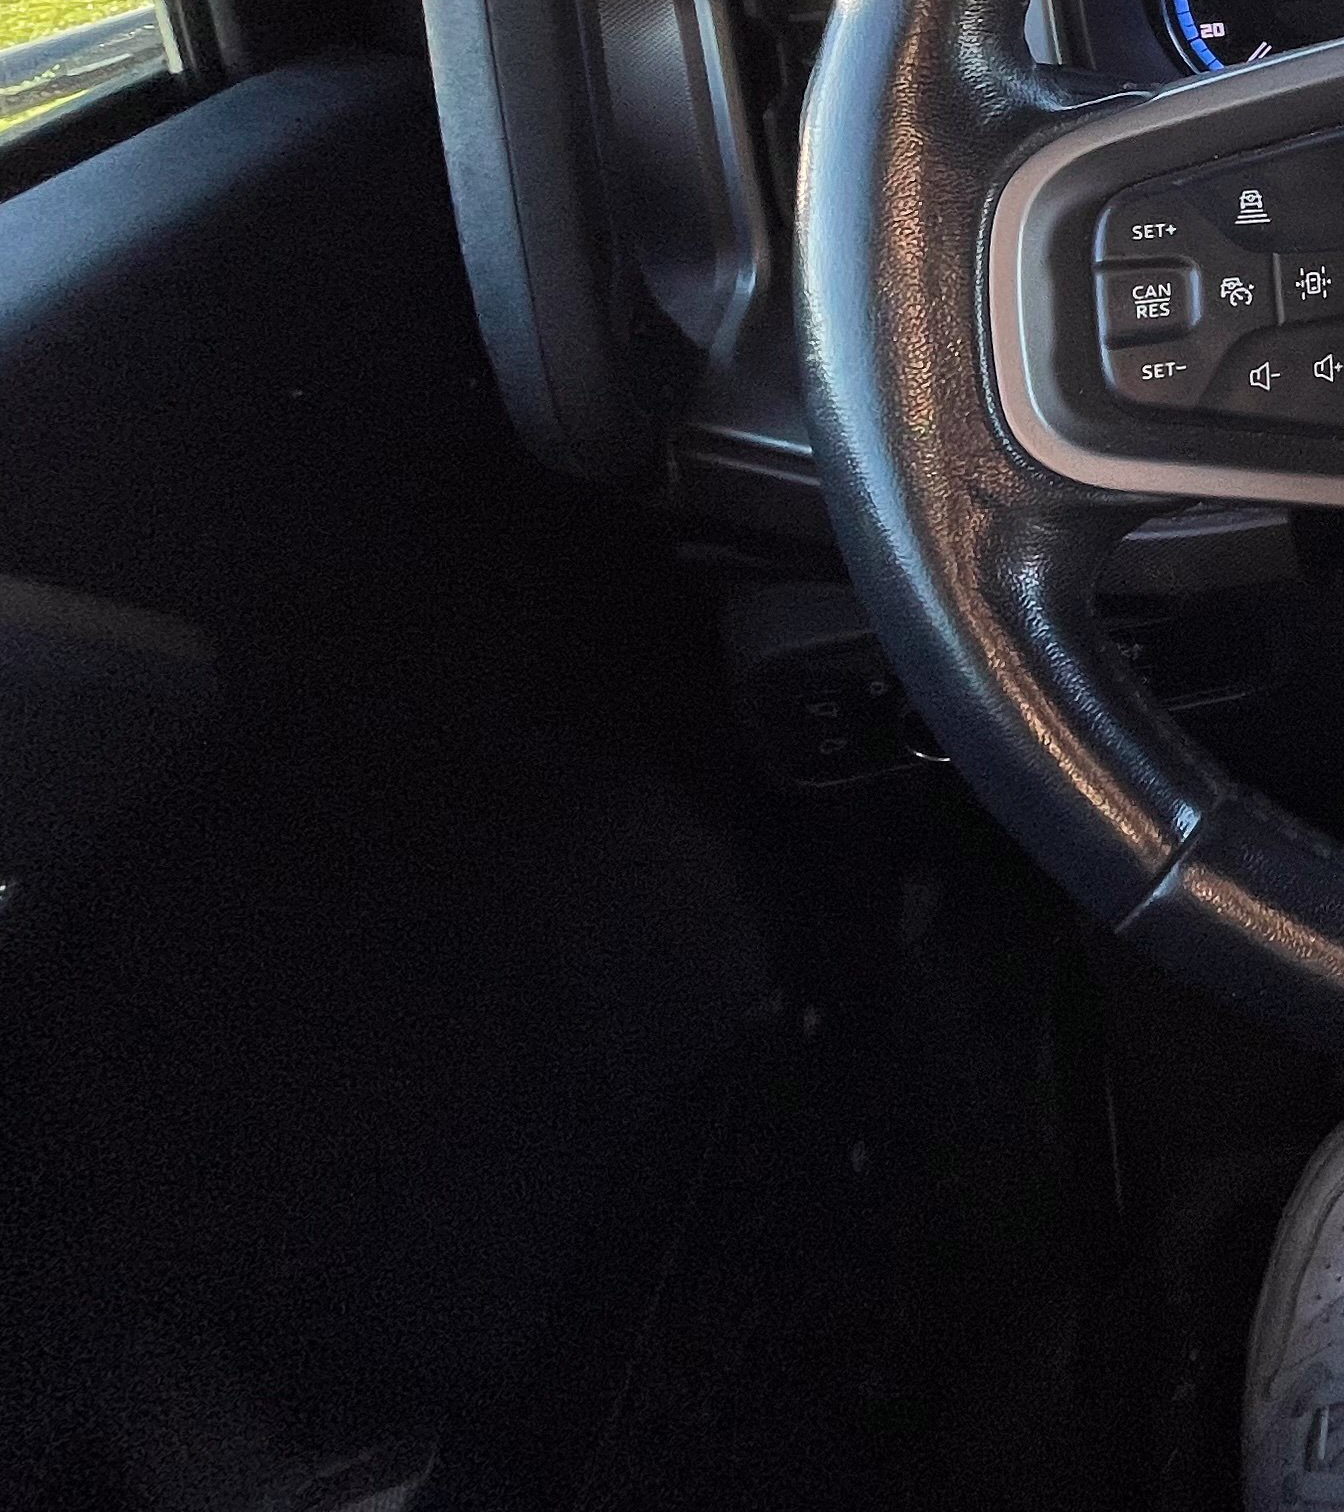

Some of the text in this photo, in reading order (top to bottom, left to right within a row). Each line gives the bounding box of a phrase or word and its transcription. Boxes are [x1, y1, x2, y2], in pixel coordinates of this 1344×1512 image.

[1199, 22, 1226, 39] 20
[1131, 222, 1178, 241] SET+
[1131, 282, 1173, 301] CAN
[1135, 301, 1171, 319] RES
[1141, 361, 1188, 381] SET-
